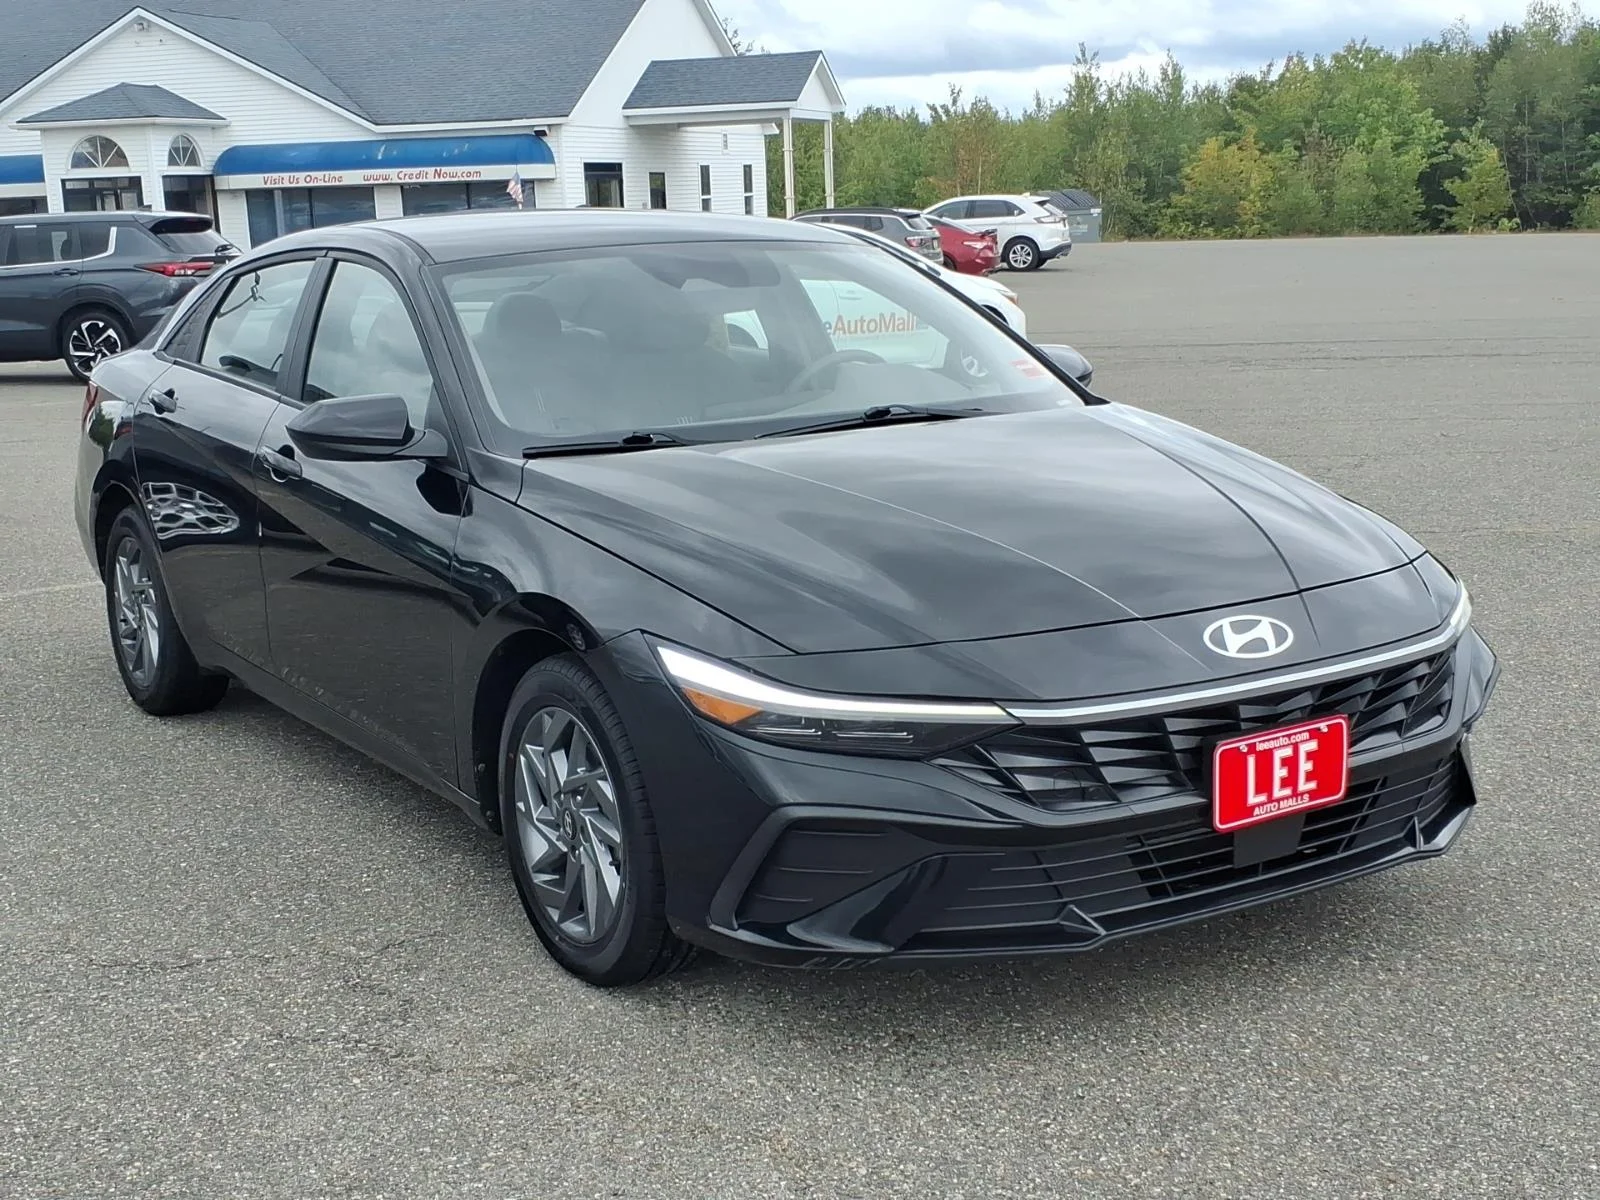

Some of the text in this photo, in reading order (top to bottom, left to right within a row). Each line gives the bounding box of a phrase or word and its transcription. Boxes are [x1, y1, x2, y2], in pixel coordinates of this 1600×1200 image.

[263, 168, 482, 186] Visit Us On-Line www. Credit Now.com
[1255, 732, 1310, 751] leeauto.com
[1247, 739, 1318, 806] LEE
[1253, 794, 1310, 816] AUTO MALLS
